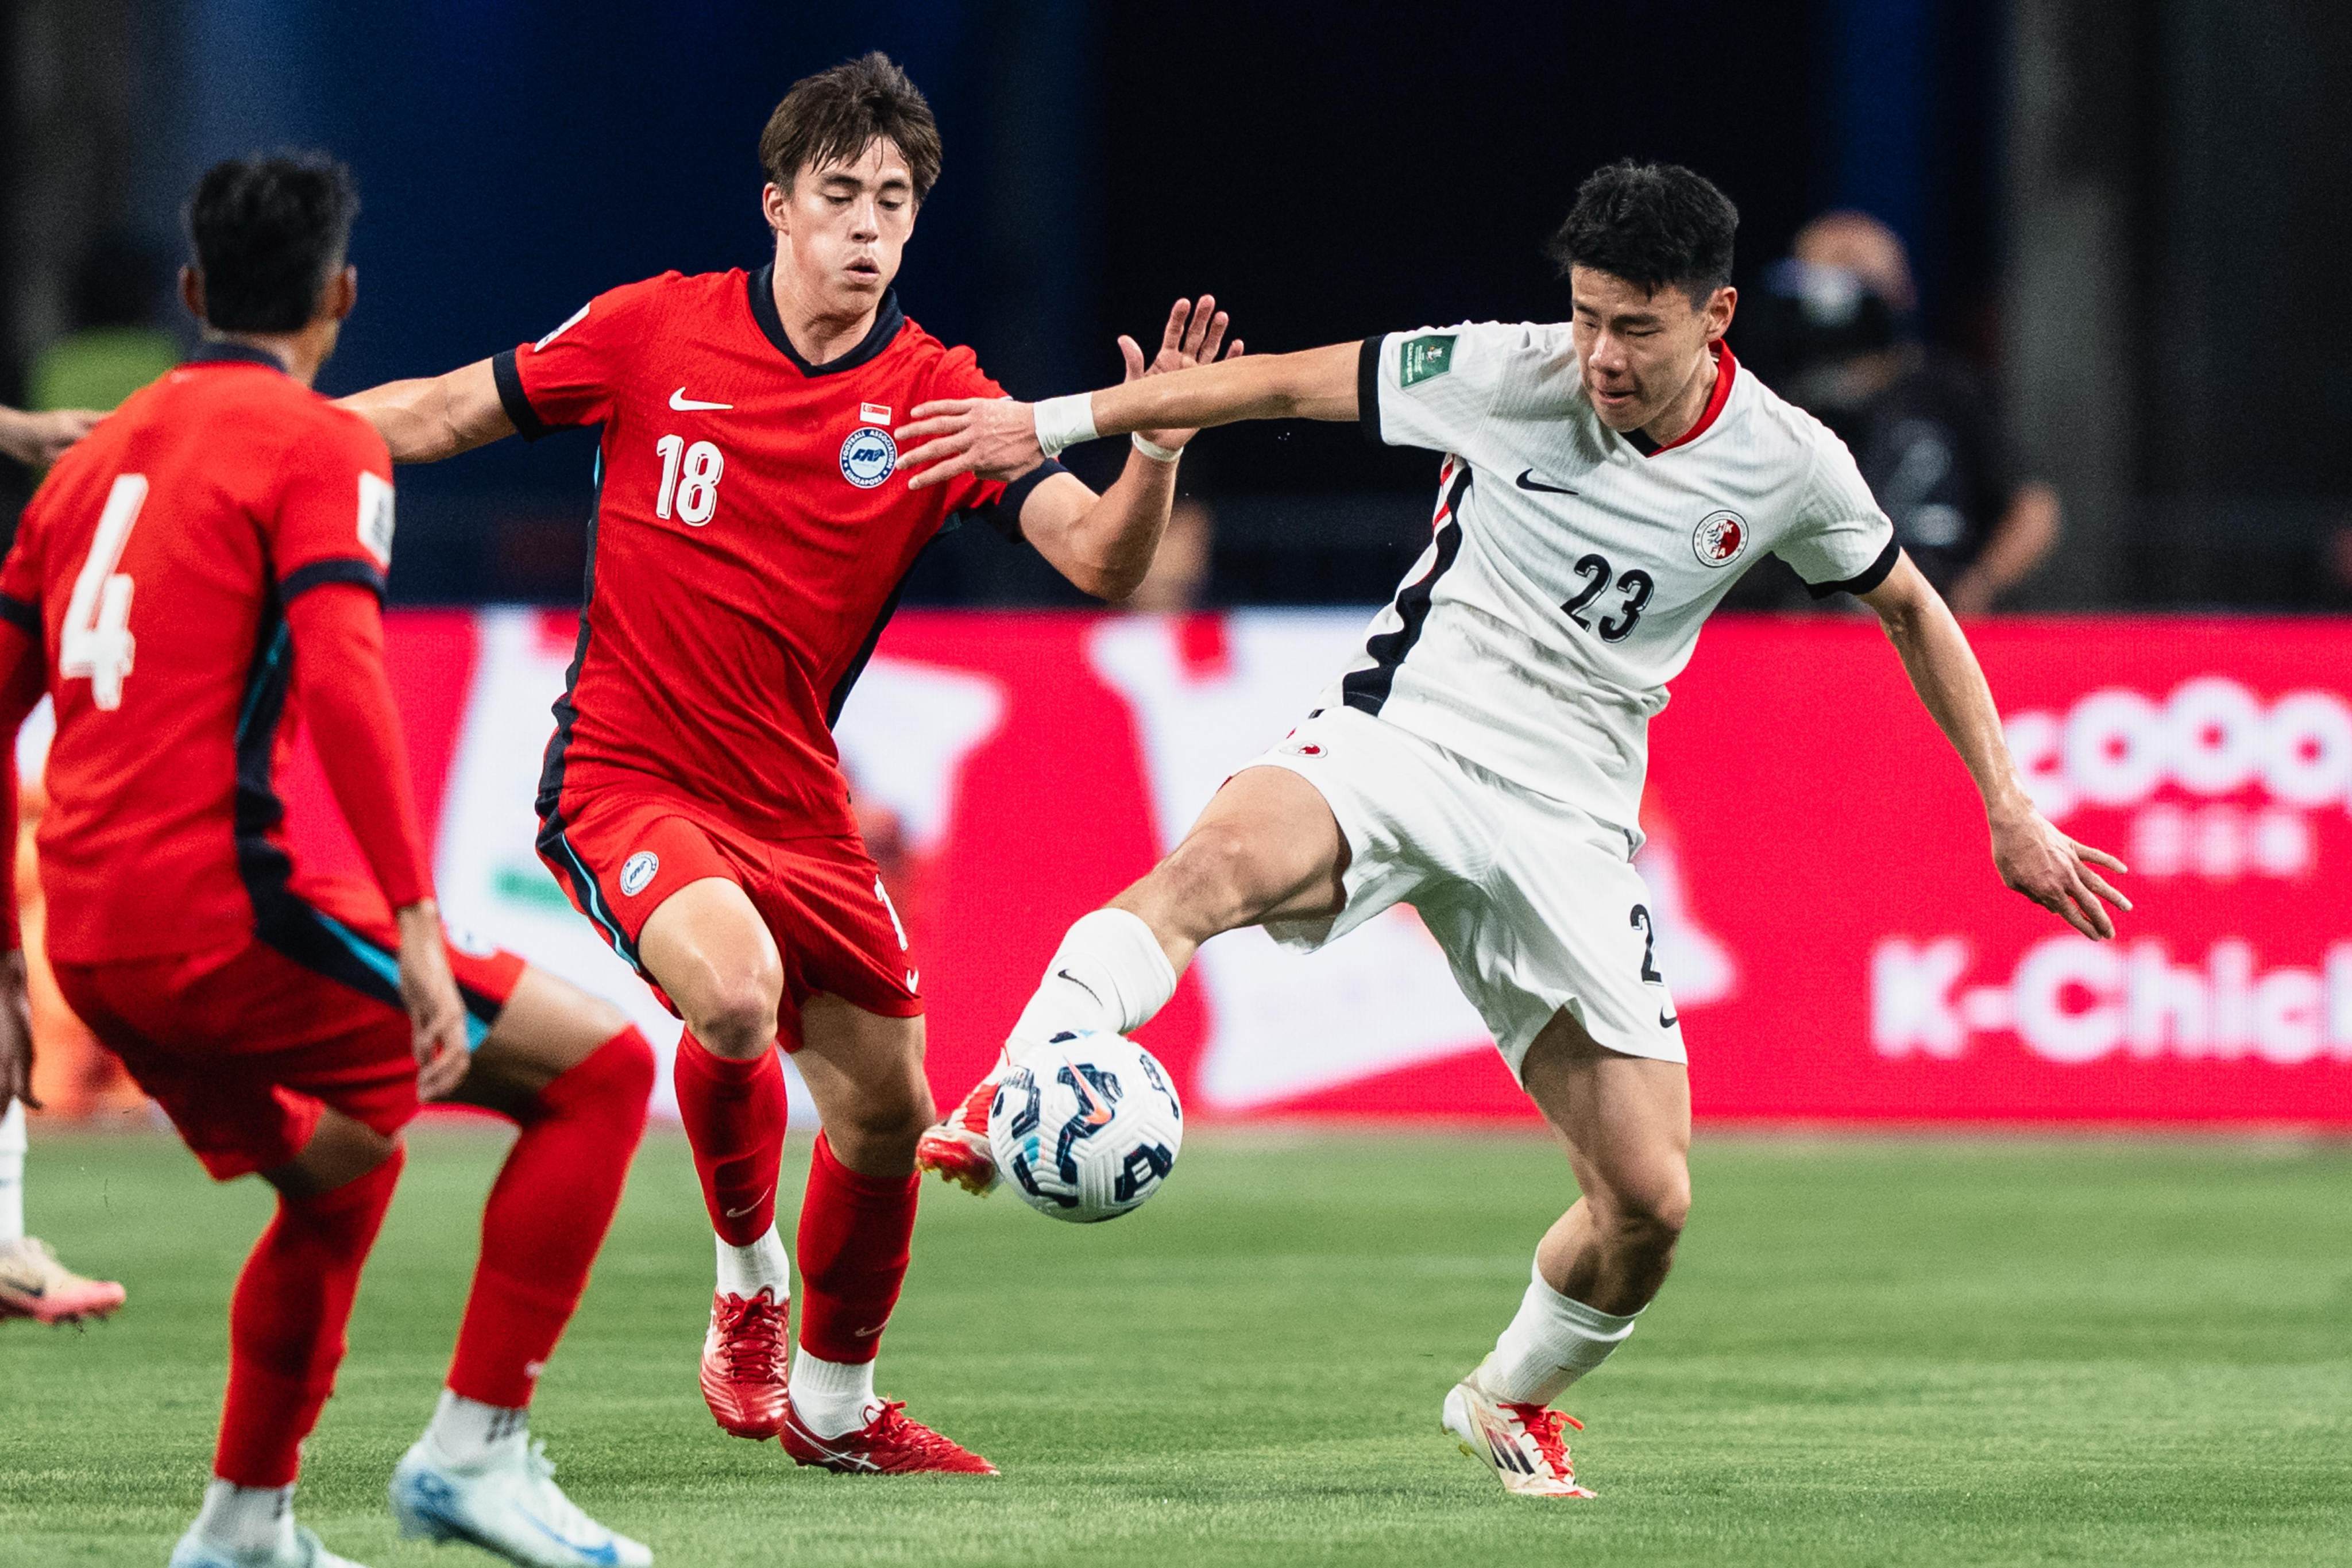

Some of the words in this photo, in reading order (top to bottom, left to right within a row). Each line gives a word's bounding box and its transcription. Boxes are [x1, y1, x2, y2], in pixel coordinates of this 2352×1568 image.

[656, 434, 724, 527] 18
[842, 430, 866, 460] FOOTBALL
[869, 430, 895, 469] ASSOCIATION
[845, 469, 883, 485] SINGAPORE
[60, 472, 149, 712] 4
[1560, 554, 1654, 643] 23
[1629, 903, 1665, 987] 2
